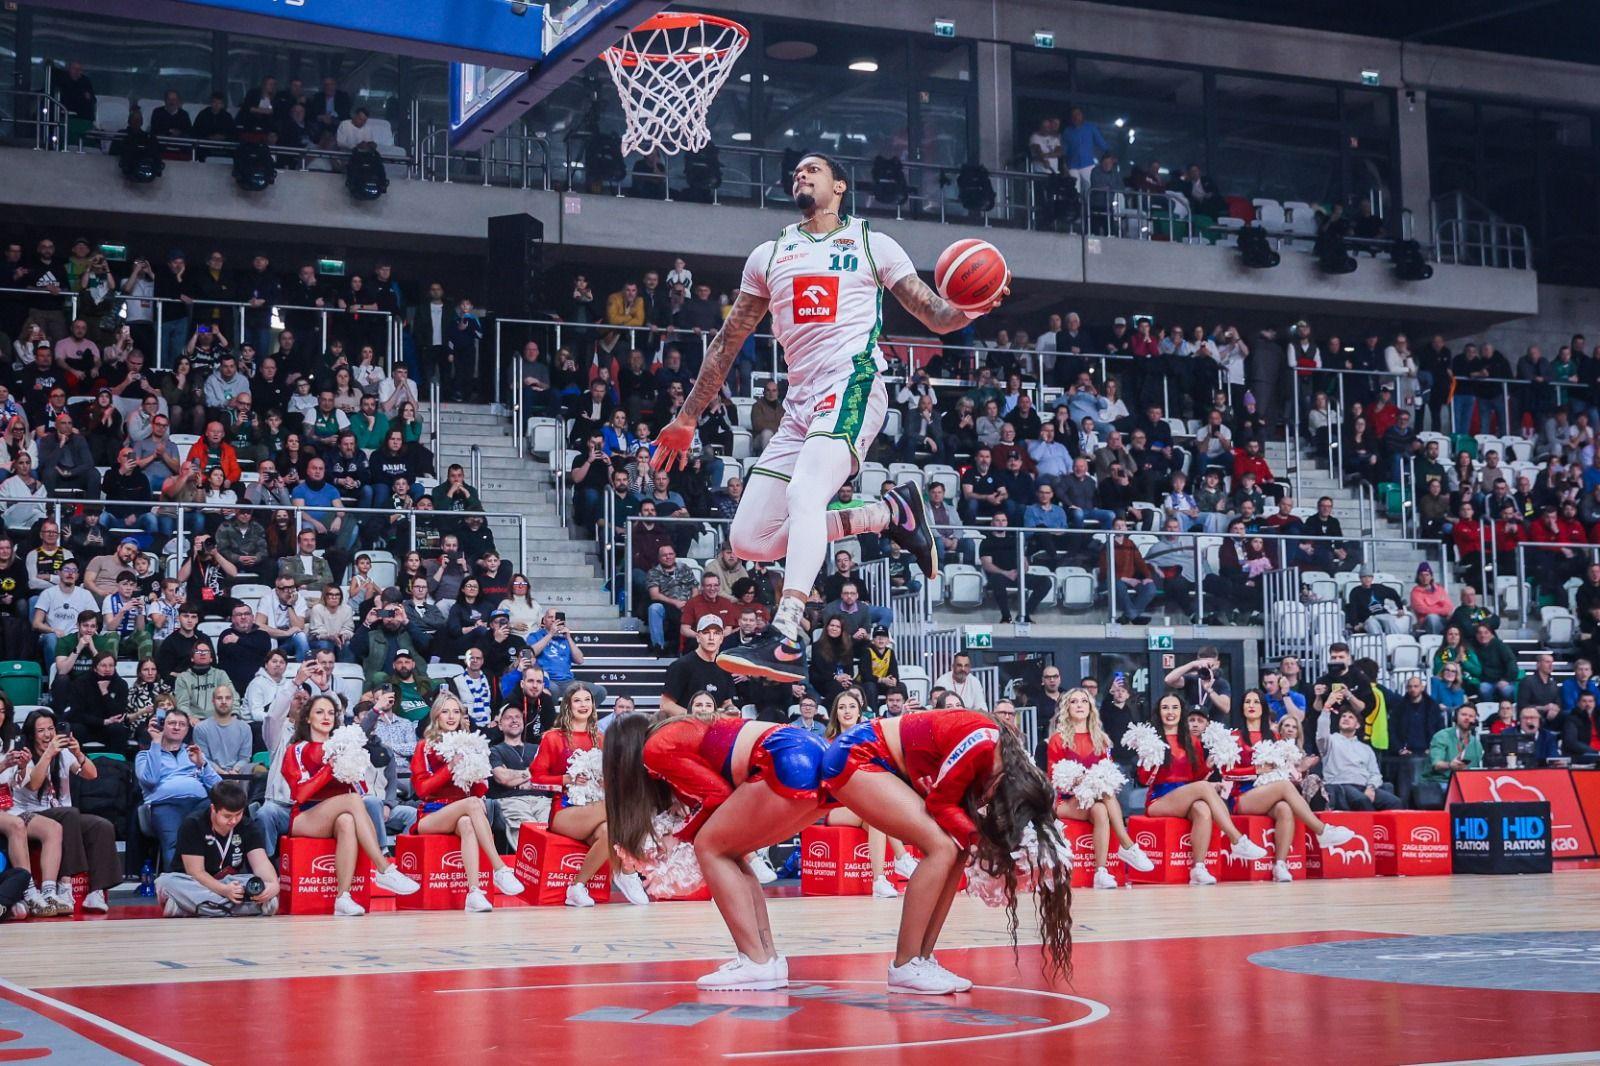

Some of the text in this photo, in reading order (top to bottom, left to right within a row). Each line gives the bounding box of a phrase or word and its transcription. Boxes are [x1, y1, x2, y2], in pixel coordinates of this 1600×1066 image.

[829, 254, 858, 271] 10
[798, 307, 830, 316] ORLEN
[609, 673, 618, 681] 04
[1132, 667, 1149, 692] 4F
[947, 732, 984, 765] SUZUKI
[1455, 817, 1489, 840] HID
[1502, 816, 1546, 840] HID
[1455, 840, 1490, 851] RATION
[1503, 840, 1546, 850] RATION
[844, 870, 860, 878] PARK
[298, 885, 319, 893] PARK
[428, 881, 449, 889] PARK
